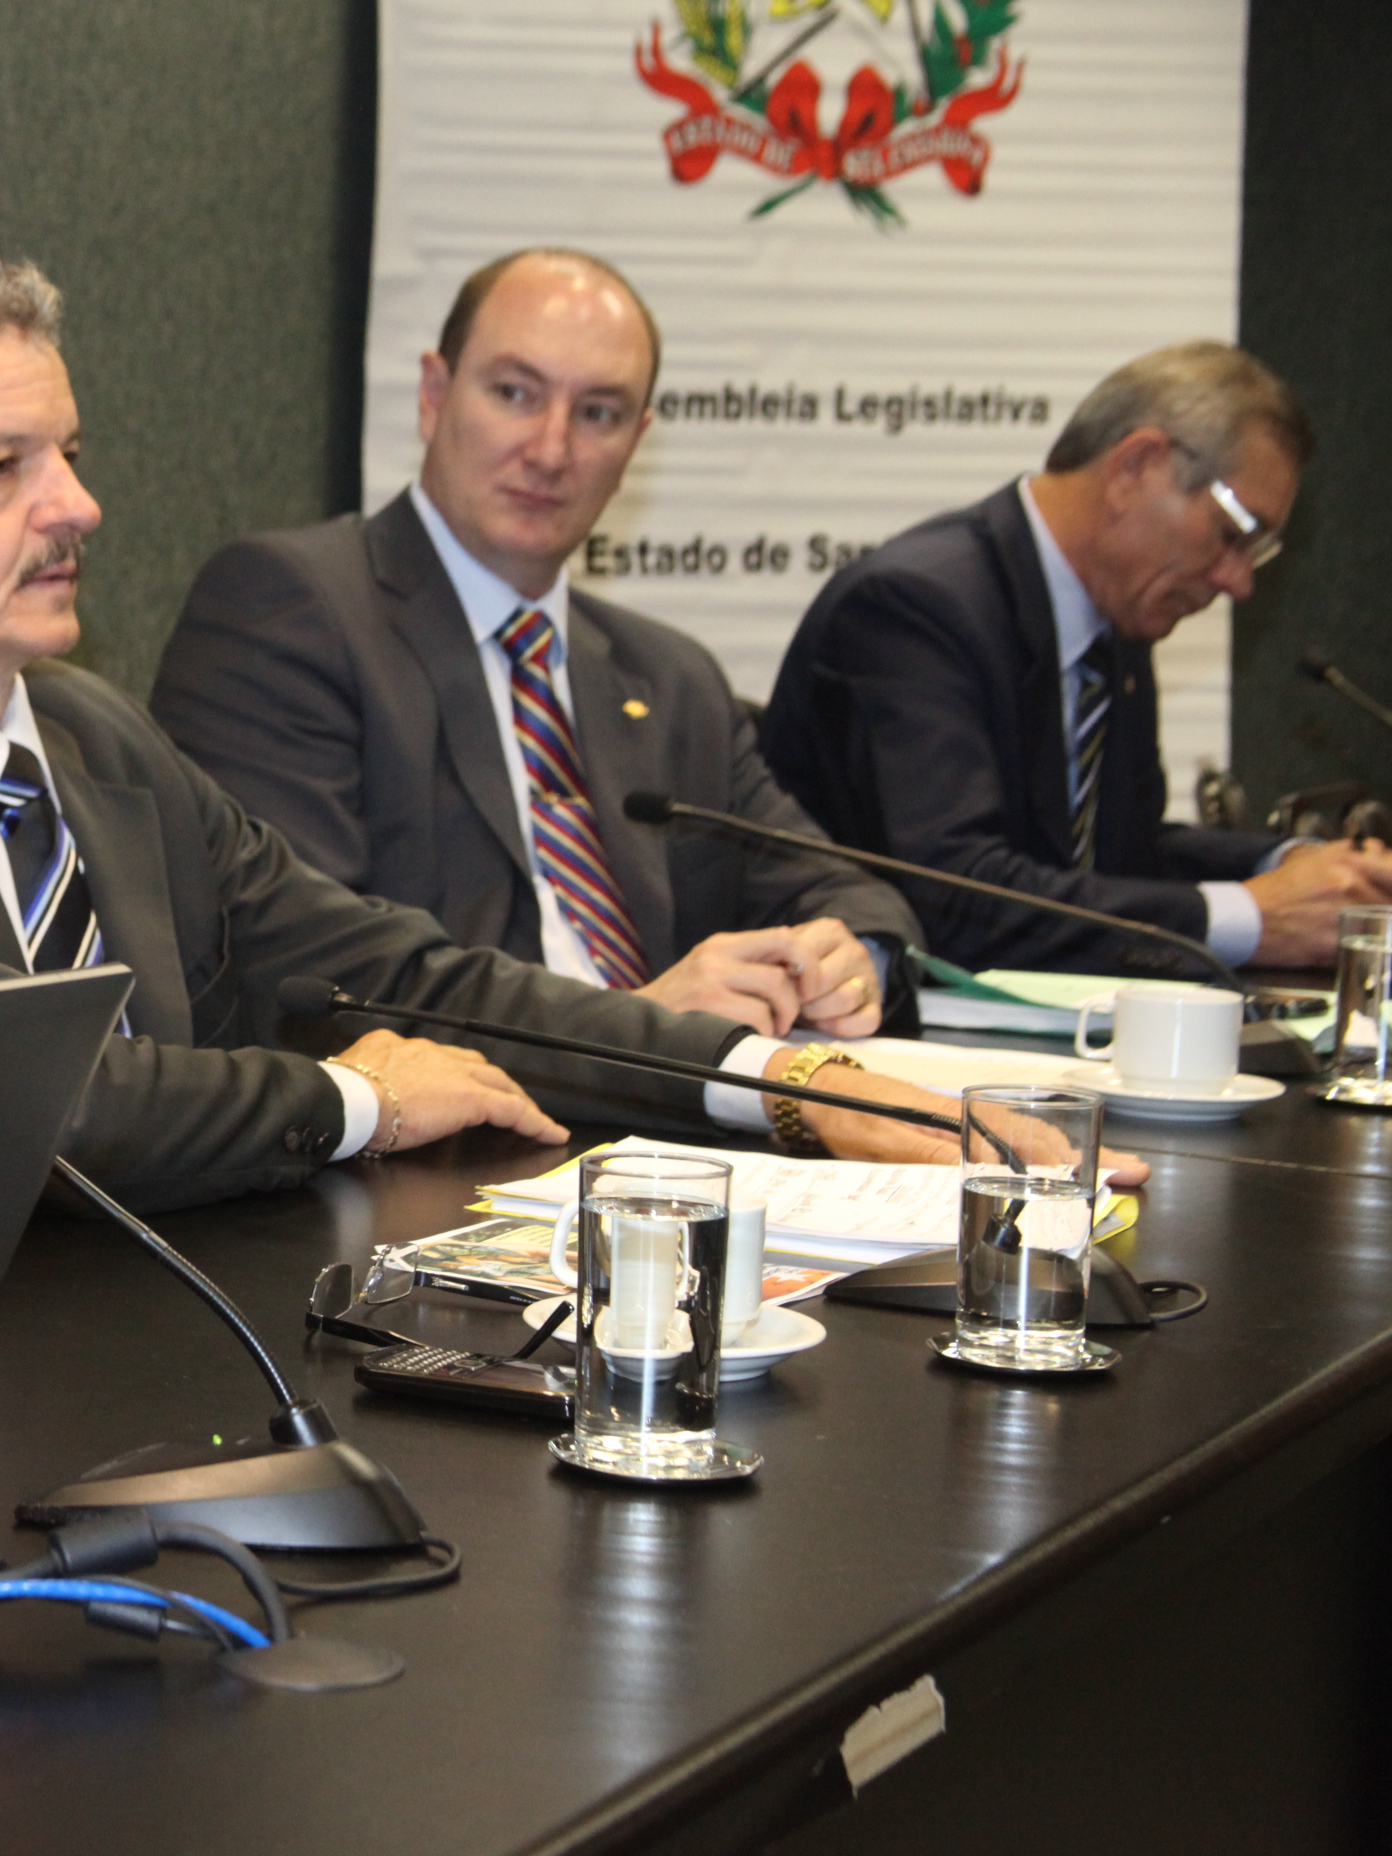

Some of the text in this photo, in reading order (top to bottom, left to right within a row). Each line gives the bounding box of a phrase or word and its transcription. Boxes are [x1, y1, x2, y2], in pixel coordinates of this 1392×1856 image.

[657, 383, 1050, 435] embleia Legislativa
[586, 534, 728, 576] Estado
[742, 535, 791, 573] de
